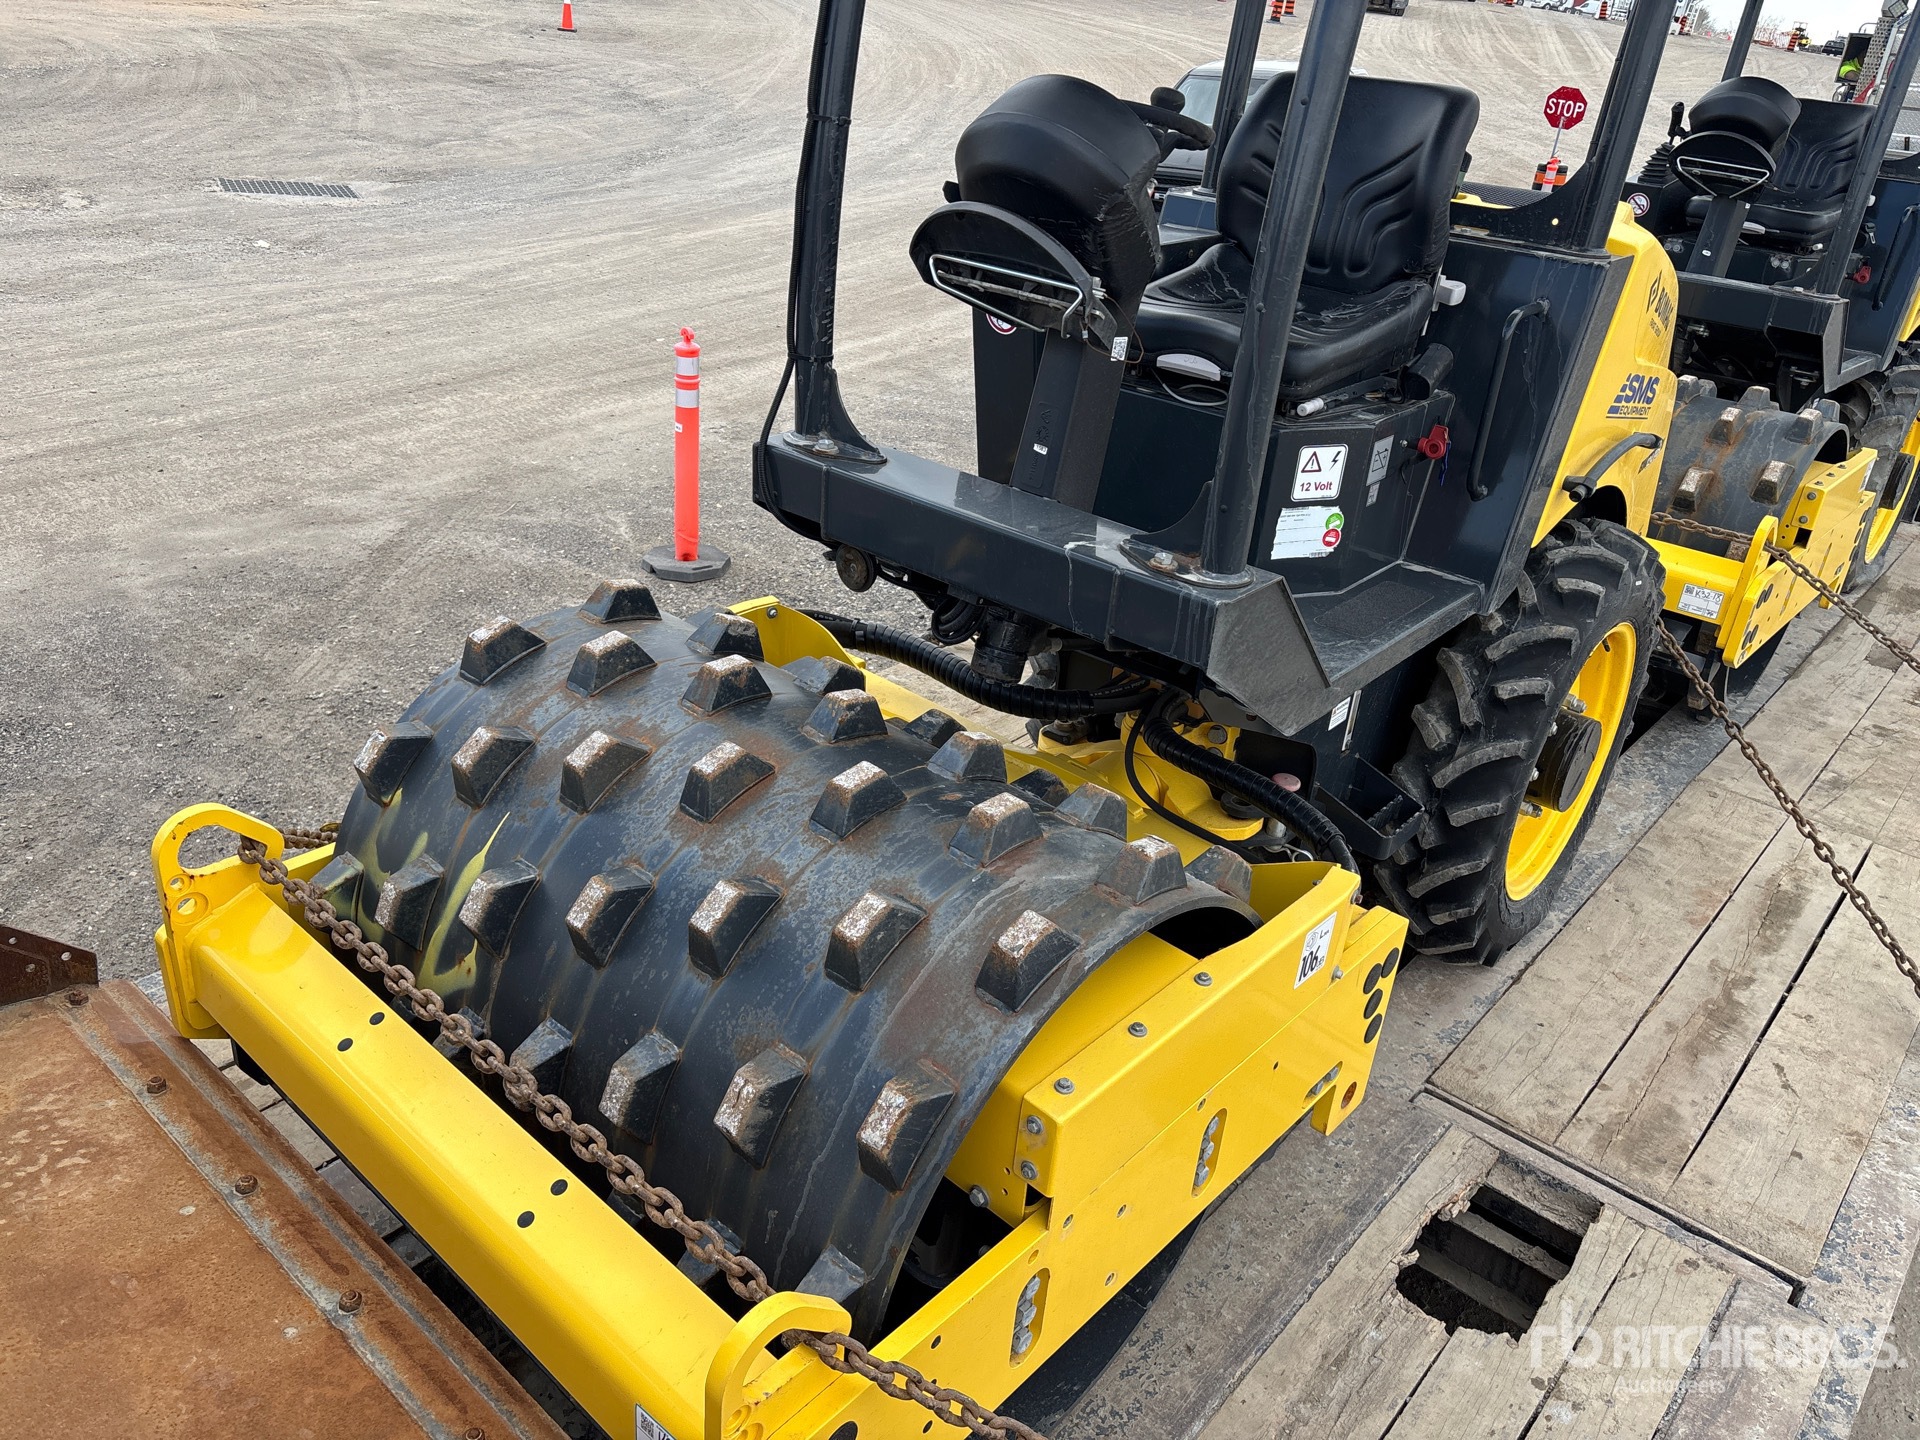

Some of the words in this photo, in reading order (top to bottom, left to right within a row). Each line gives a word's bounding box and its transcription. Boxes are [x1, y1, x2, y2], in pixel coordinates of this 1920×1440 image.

[1546, 97, 1585, 118] STOP
[1623, 373, 1660, 405] SMS
[1619, 405, 1651, 416] EQUIPMENT
[1300, 482, 1312, 492] 12
[1314, 481, 1333, 491] Volt
[1298, 945, 1320, 982] 106
